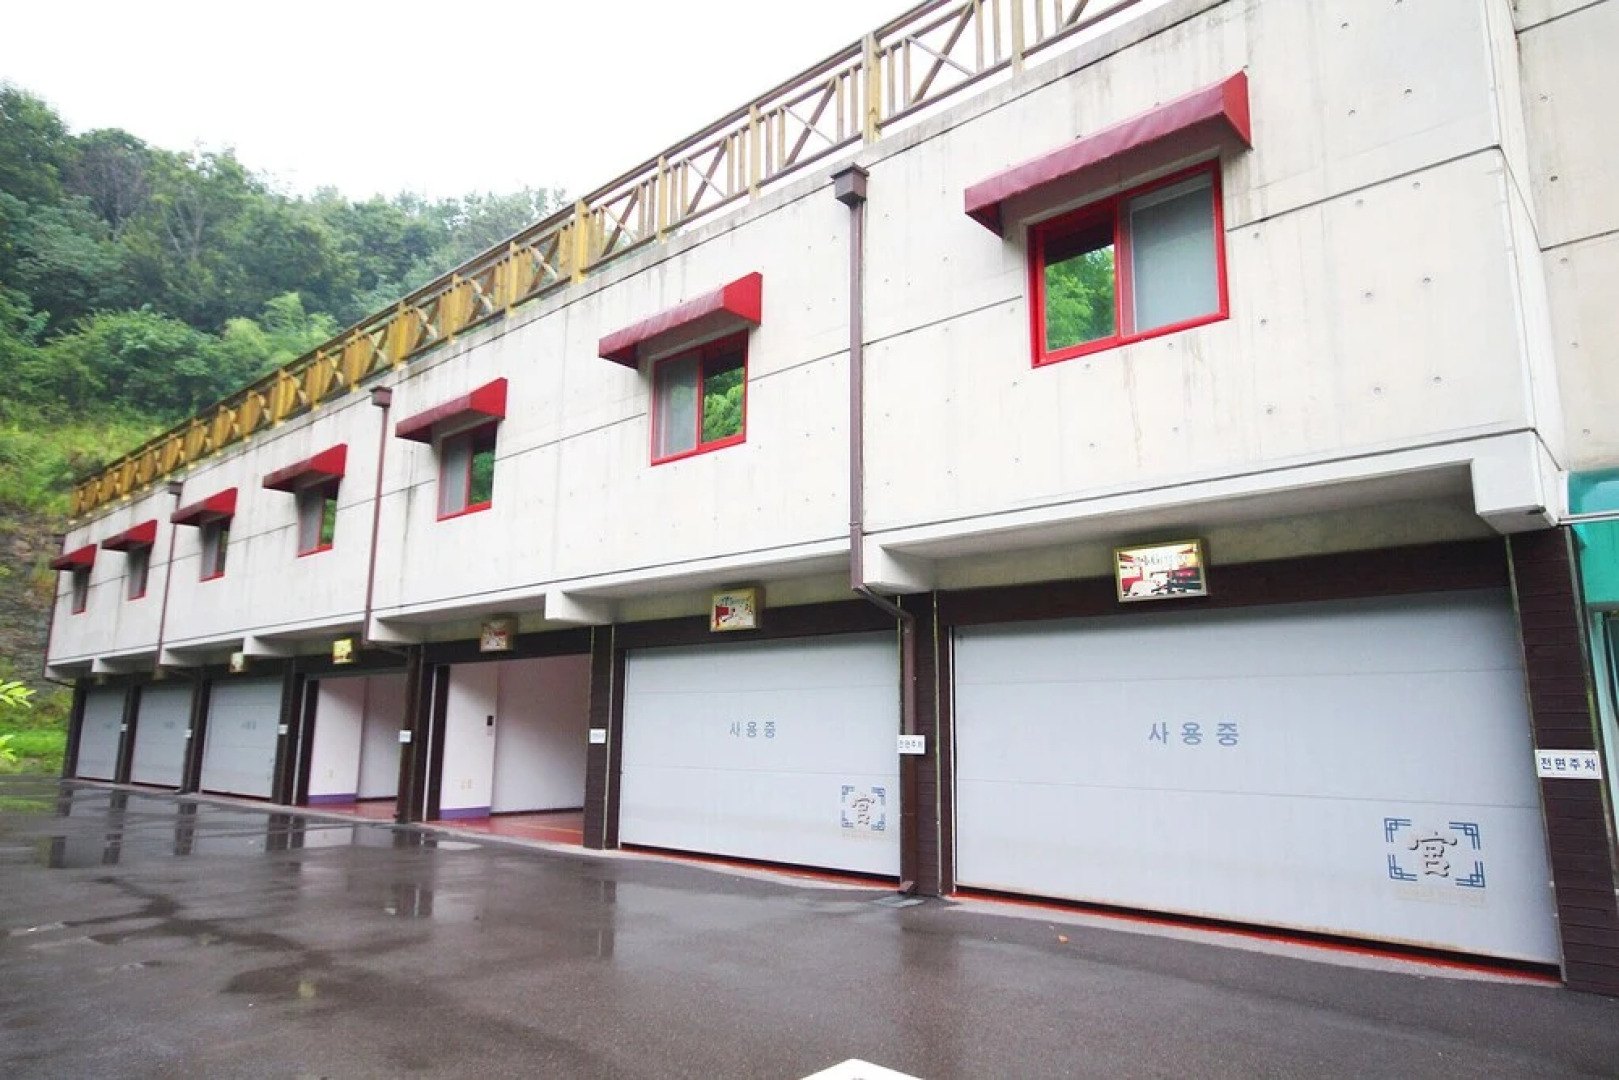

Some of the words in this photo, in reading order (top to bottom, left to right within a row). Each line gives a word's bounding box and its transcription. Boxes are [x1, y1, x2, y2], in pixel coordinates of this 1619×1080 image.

[729, 721, 776, 738] 사용중
[1148, 721, 1239, 746] 사용중
[1540, 757, 1596, 772] 전면주차
